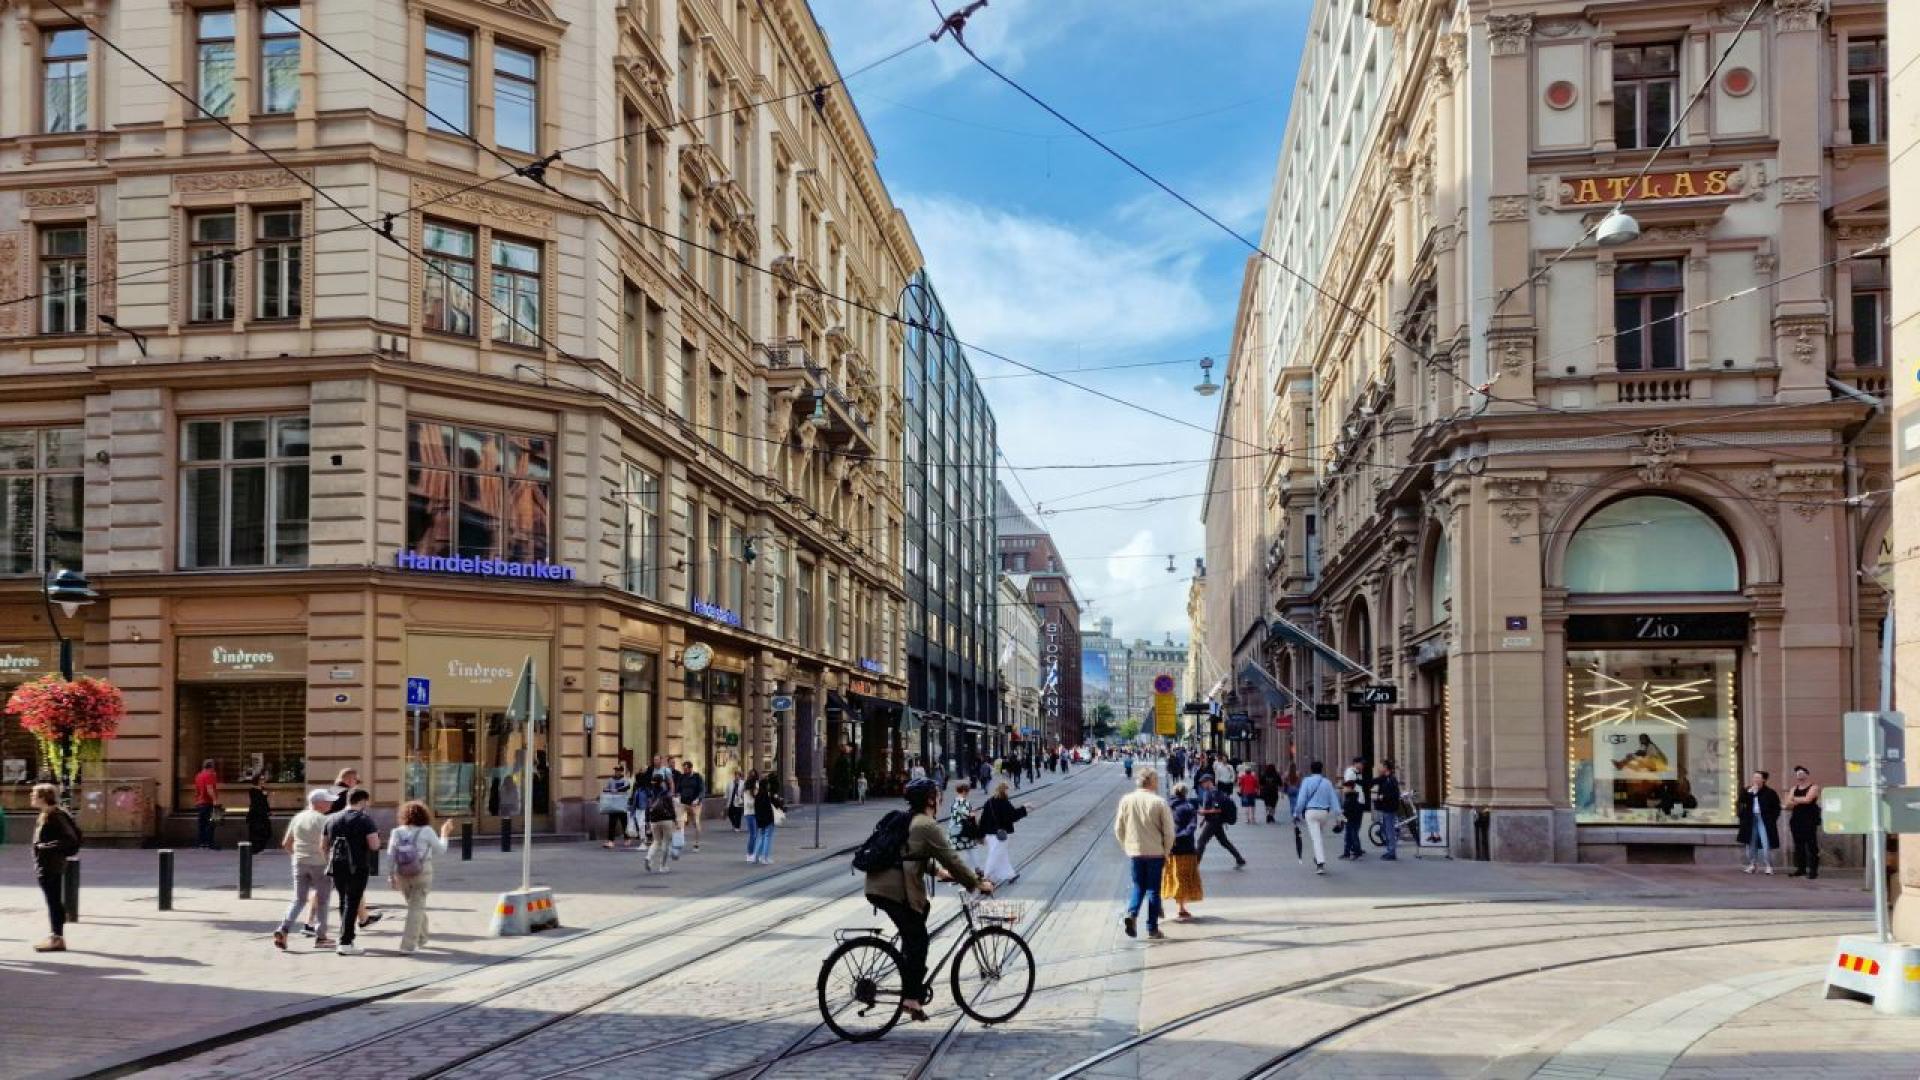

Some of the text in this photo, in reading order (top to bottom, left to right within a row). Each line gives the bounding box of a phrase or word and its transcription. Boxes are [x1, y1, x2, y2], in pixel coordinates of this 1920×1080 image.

[1574, 171, 1728, 203] ATLAS
[397, 551, 576, 580] Handelsbanken
[1636, 617, 1679, 638] Zio
